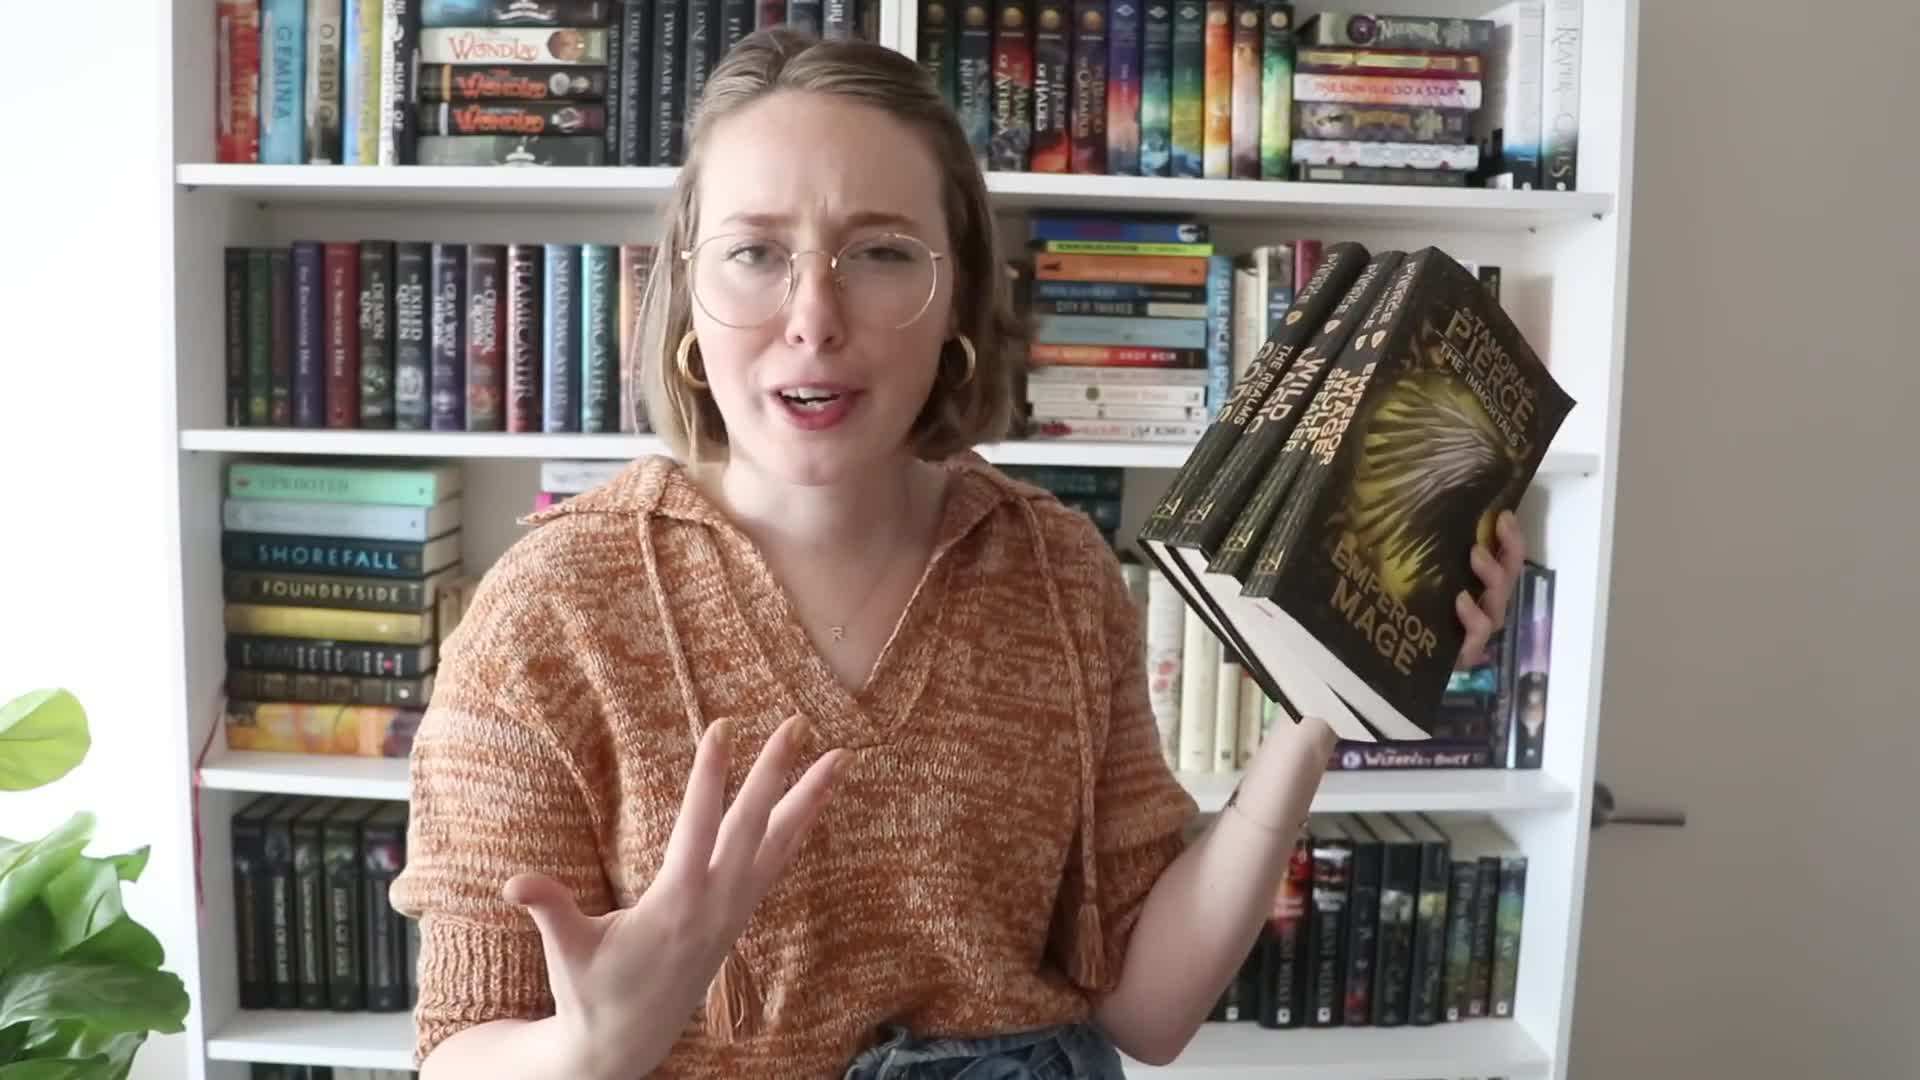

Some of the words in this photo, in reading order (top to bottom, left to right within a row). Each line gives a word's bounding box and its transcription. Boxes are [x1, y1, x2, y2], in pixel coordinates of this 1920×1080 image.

[663, 12, 675, 47] TWO
[274, 25, 293, 120] GEMINA
[394, 60, 406, 102] MUSE
[661, 52, 673, 97] DARK
[996, 71, 1013, 135] ATHENA
[1415, 85, 1424, 97] A
[394, 109, 406, 130] OF
[659, 101, 673, 158] REIGNS
[1035, 79, 1050, 132] HADES
[371, 282, 386, 340] DEMON
[395, 283, 410, 340] QUEEN
[409, 283, 424, 341] EXILED
[443, 319, 458, 357] WOLF
[468, 293, 484, 347] CROWN
[481, 288, 497, 354] CRIMSON
[513, 260, 533, 405] FLAMECASTER
[554, 259, 570, 408] SHADOWCASTER
[590, 260, 608, 406] STORMCASTER
[1215, 279, 1231, 353] SILENCE
[1269, 344, 1294, 371] THE
[1444, 308, 1534, 433] PIERCE
[1470, 316, 1528, 396] TAMORA
[1233, 371, 1275, 426] REALMS
[1268, 357, 1327, 421] WILD
[1281, 367, 1342, 452] SPEAKER
[1310, 375, 1360, 455] MAGE
[1319, 361, 1376, 466] EMPEROR
[1438, 339, 1464, 374] THE
[1464, 370, 1522, 447] IMMORTALS
[259, 544, 400, 571] SHOREFALL
[262, 579, 400, 603] FOUNDRYSIDE
[1330, 540, 1438, 657] EMPEROR
[1330, 577, 1418, 676] MAGE
